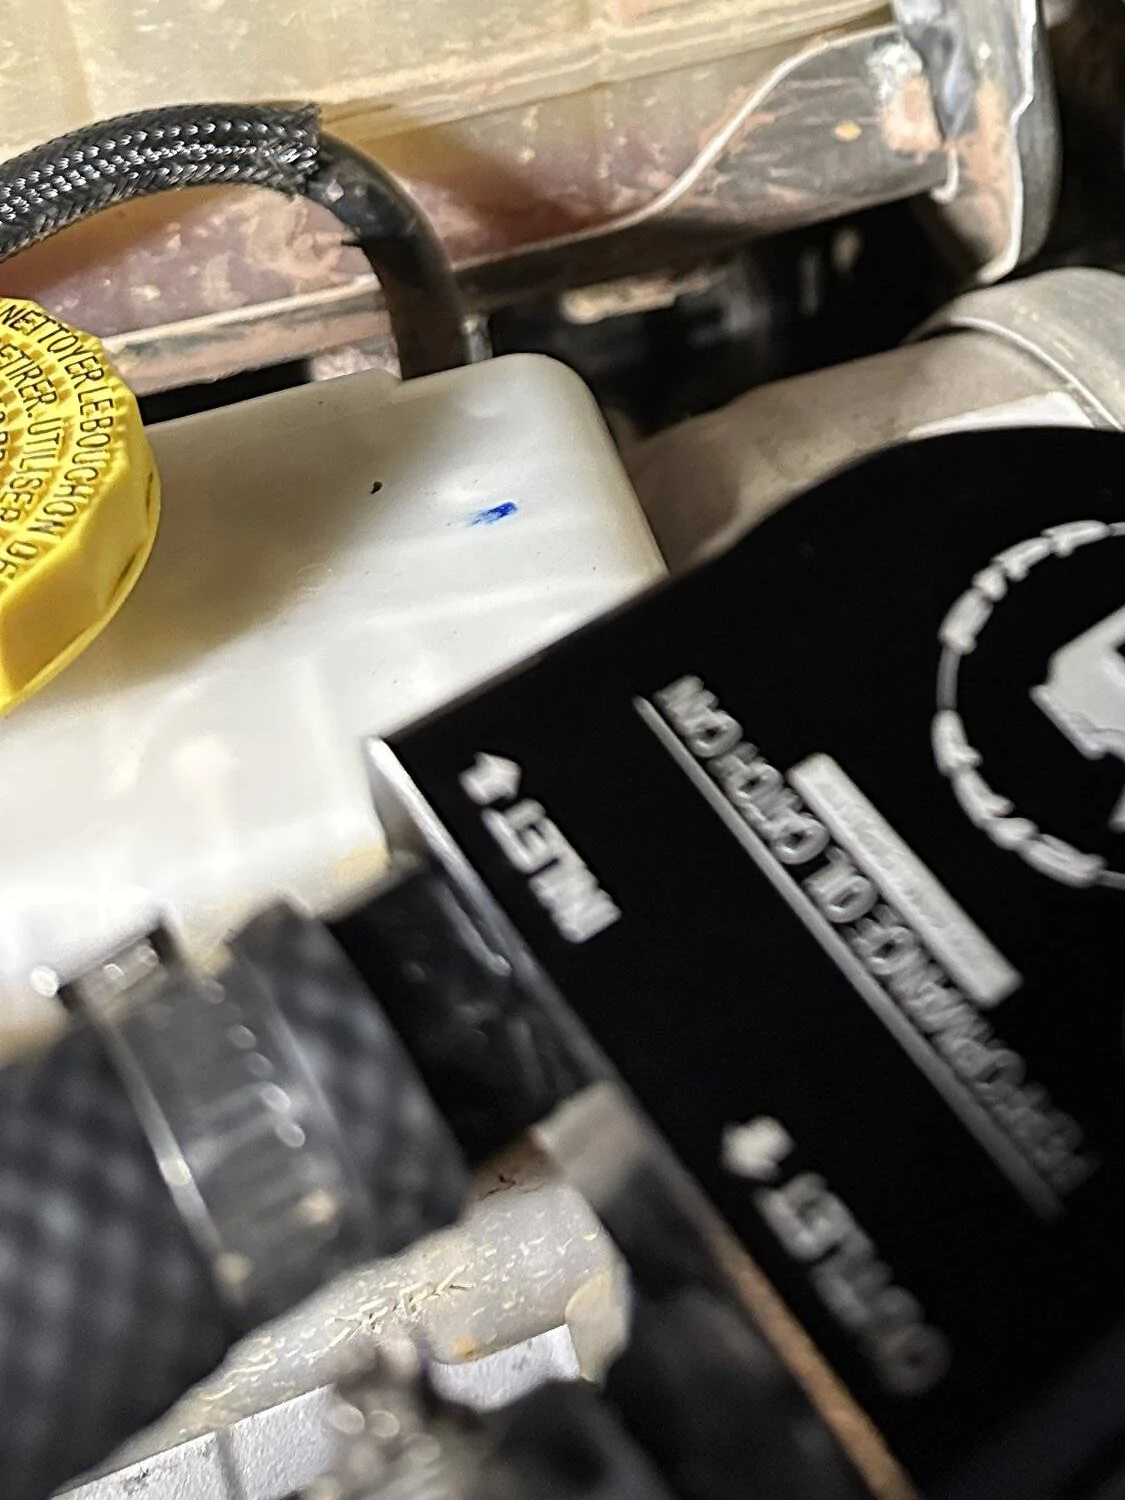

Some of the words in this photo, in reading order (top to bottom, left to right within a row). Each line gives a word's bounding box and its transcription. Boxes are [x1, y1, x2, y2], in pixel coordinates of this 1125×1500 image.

[0, 304, 105, 389] NETTOYER
[78, 385, 114, 416] LE
[0, 417, 63, 522] UTILISER
[27, 416, 114, 537] BOUCHON
[652, 673, 744, 757] CAN
[705, 740, 830, 865] CATCH
[482, 796, 622, 944] INLET
[793, 846, 877, 922] OIL
[755, 1169, 953, 1397] OUTLET
